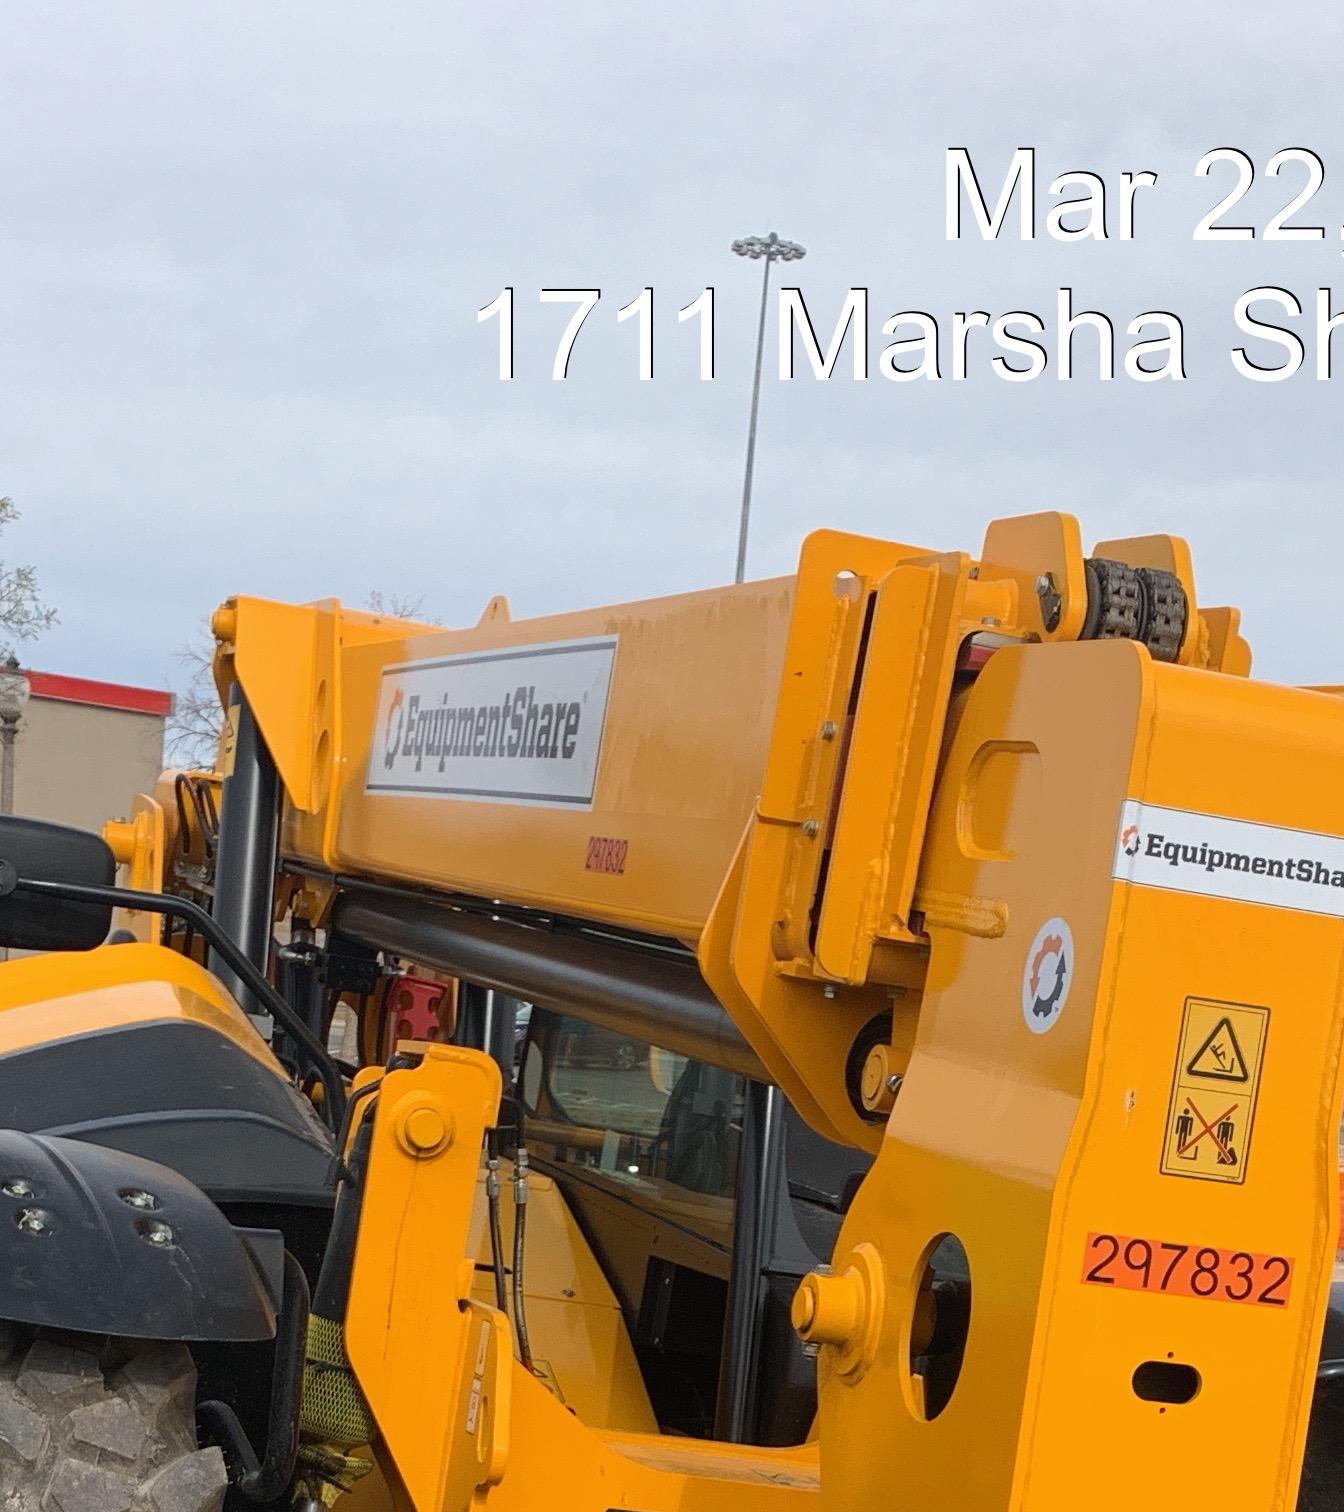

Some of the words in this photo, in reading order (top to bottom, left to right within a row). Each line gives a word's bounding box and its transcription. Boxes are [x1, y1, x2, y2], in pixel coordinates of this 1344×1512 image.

[402, 686, 581, 772] EquipmentShare
[586, 836, 628, 874] 297832
[1085, 1234, 1291, 1306] 297832
